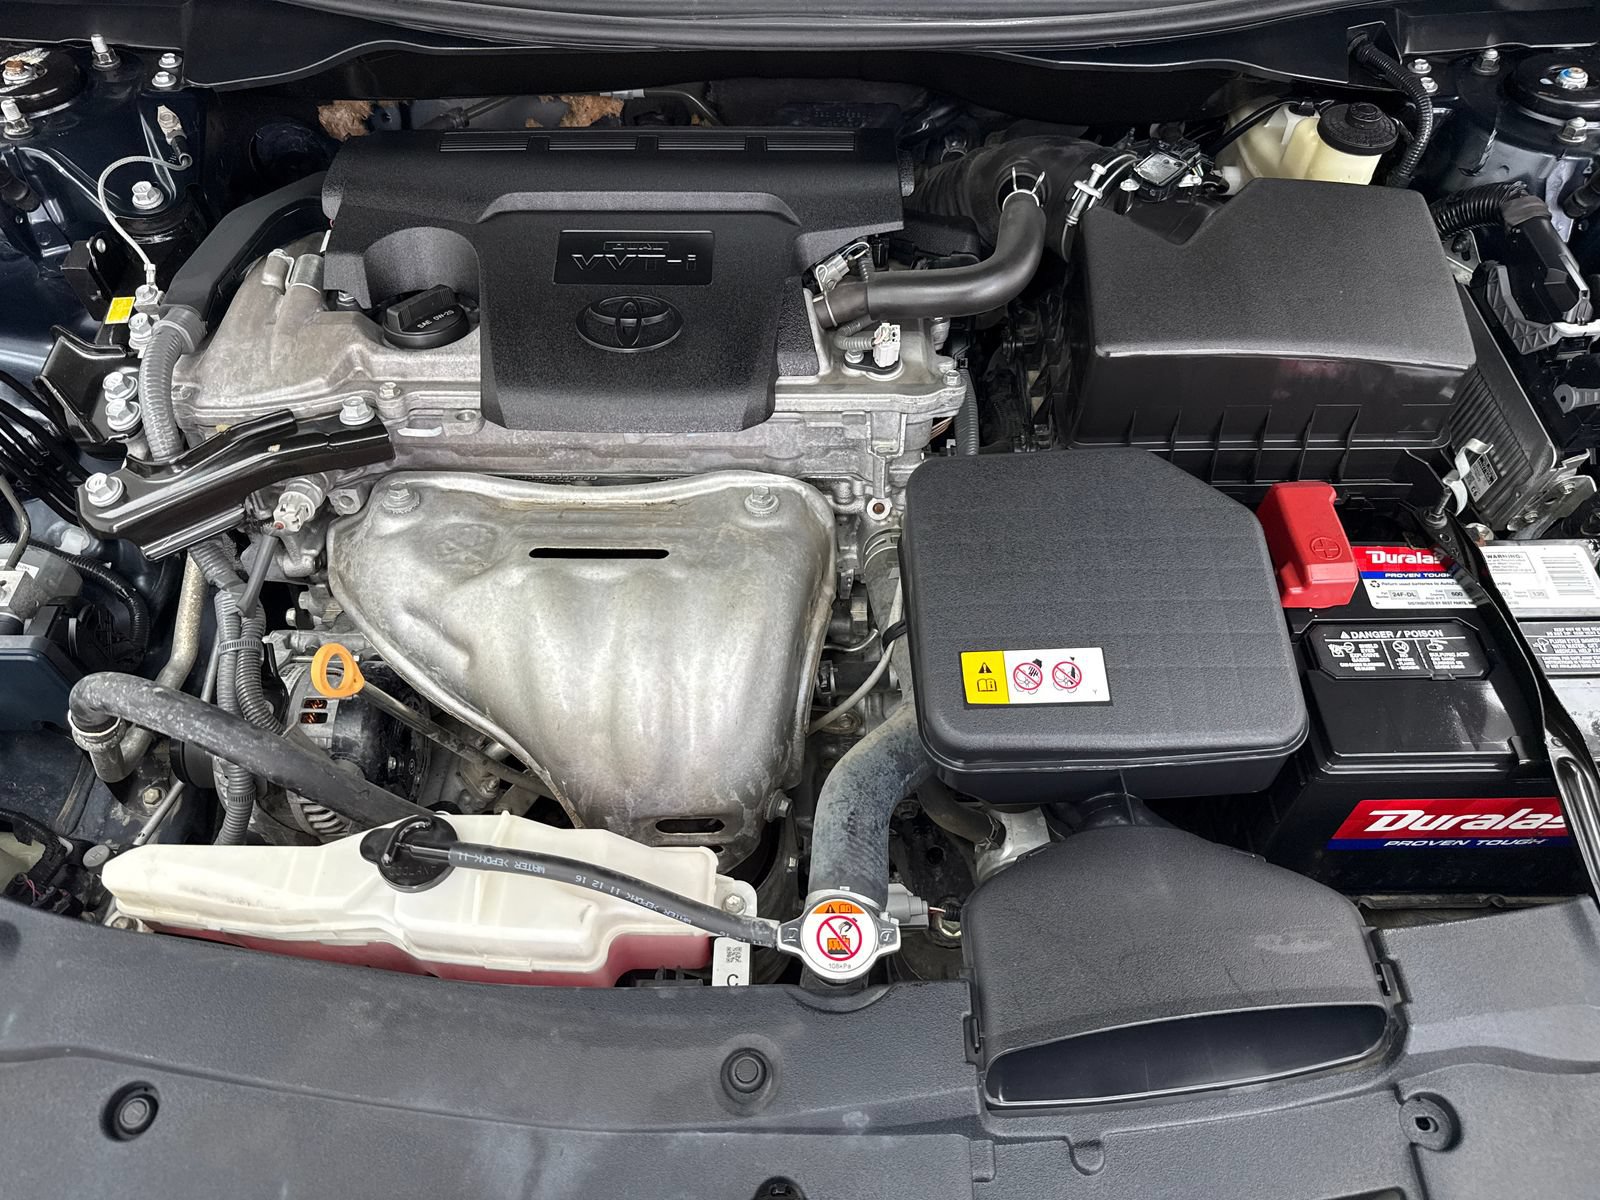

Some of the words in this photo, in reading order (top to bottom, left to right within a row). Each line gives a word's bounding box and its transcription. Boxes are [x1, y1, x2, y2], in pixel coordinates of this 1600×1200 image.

[571, 254, 697, 271] VVT-i
[417, 320, 432, 329] SAE
[1350, 631, 1394, 639] DANGER
[1384, 839, 1472, 847] PROVEN
[1476, 837, 1548, 846] TOUGH
[514, 860, 546, 874] WATER
[575, 874, 588, 884] 16
[591, 879, 604, 890] 12
